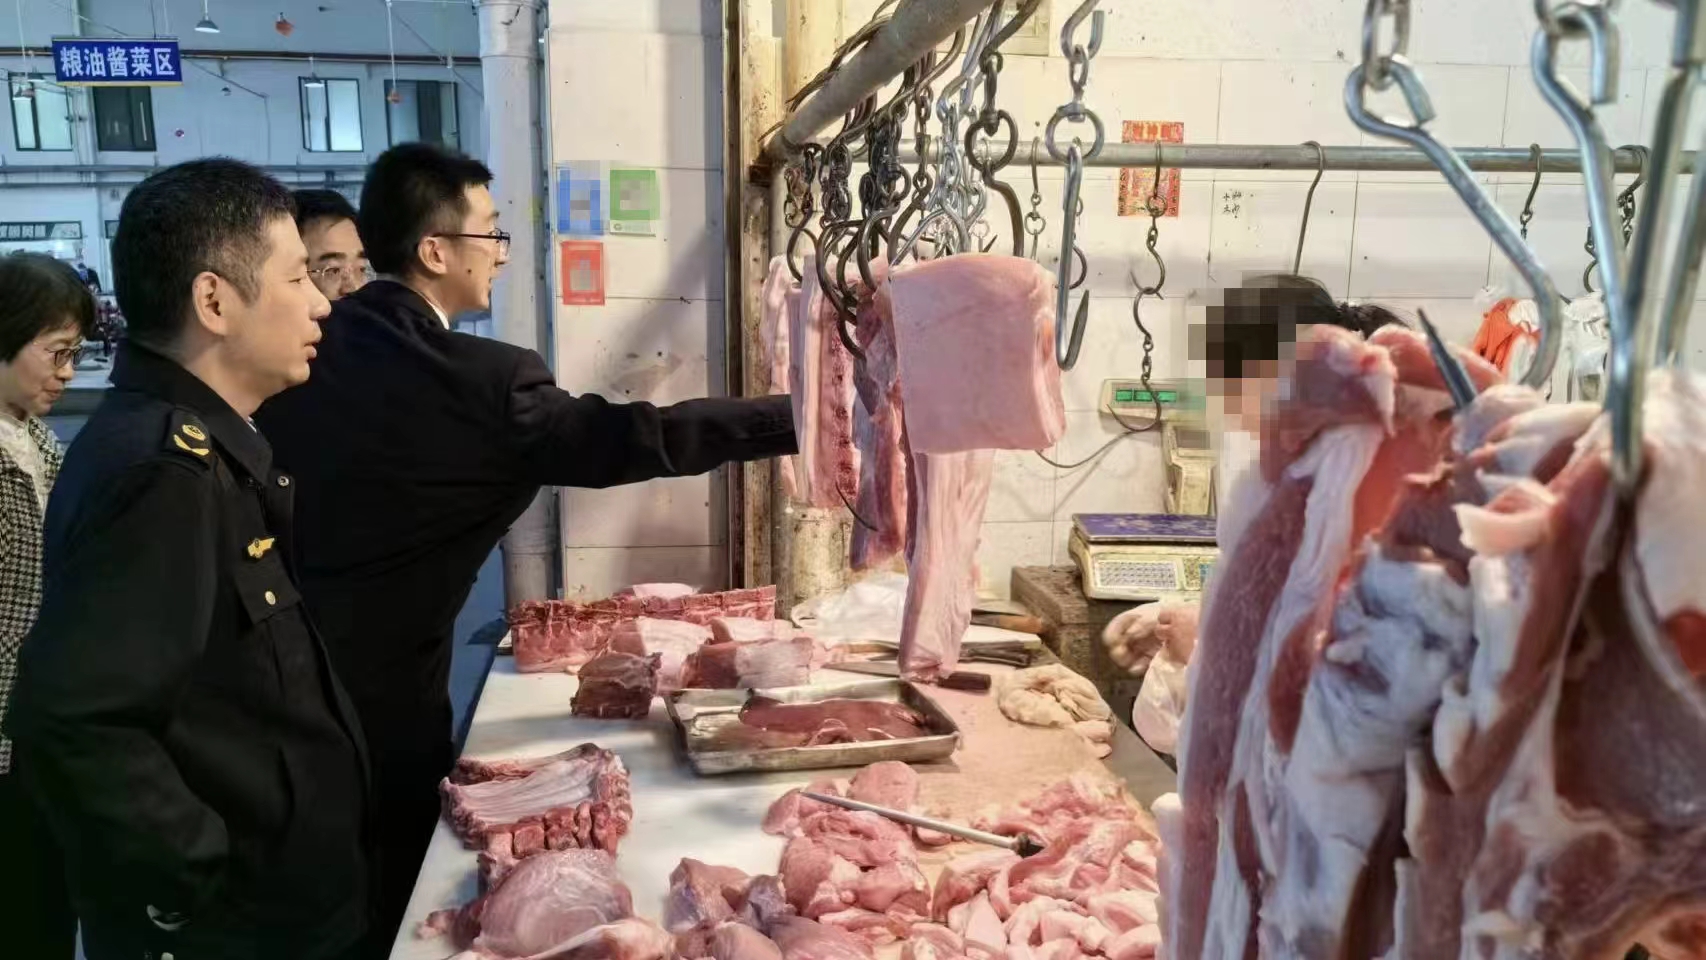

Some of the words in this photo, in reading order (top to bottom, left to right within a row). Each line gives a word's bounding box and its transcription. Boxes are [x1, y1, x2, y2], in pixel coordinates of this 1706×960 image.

[60, 46, 176, 77] 粮油酱菜区
